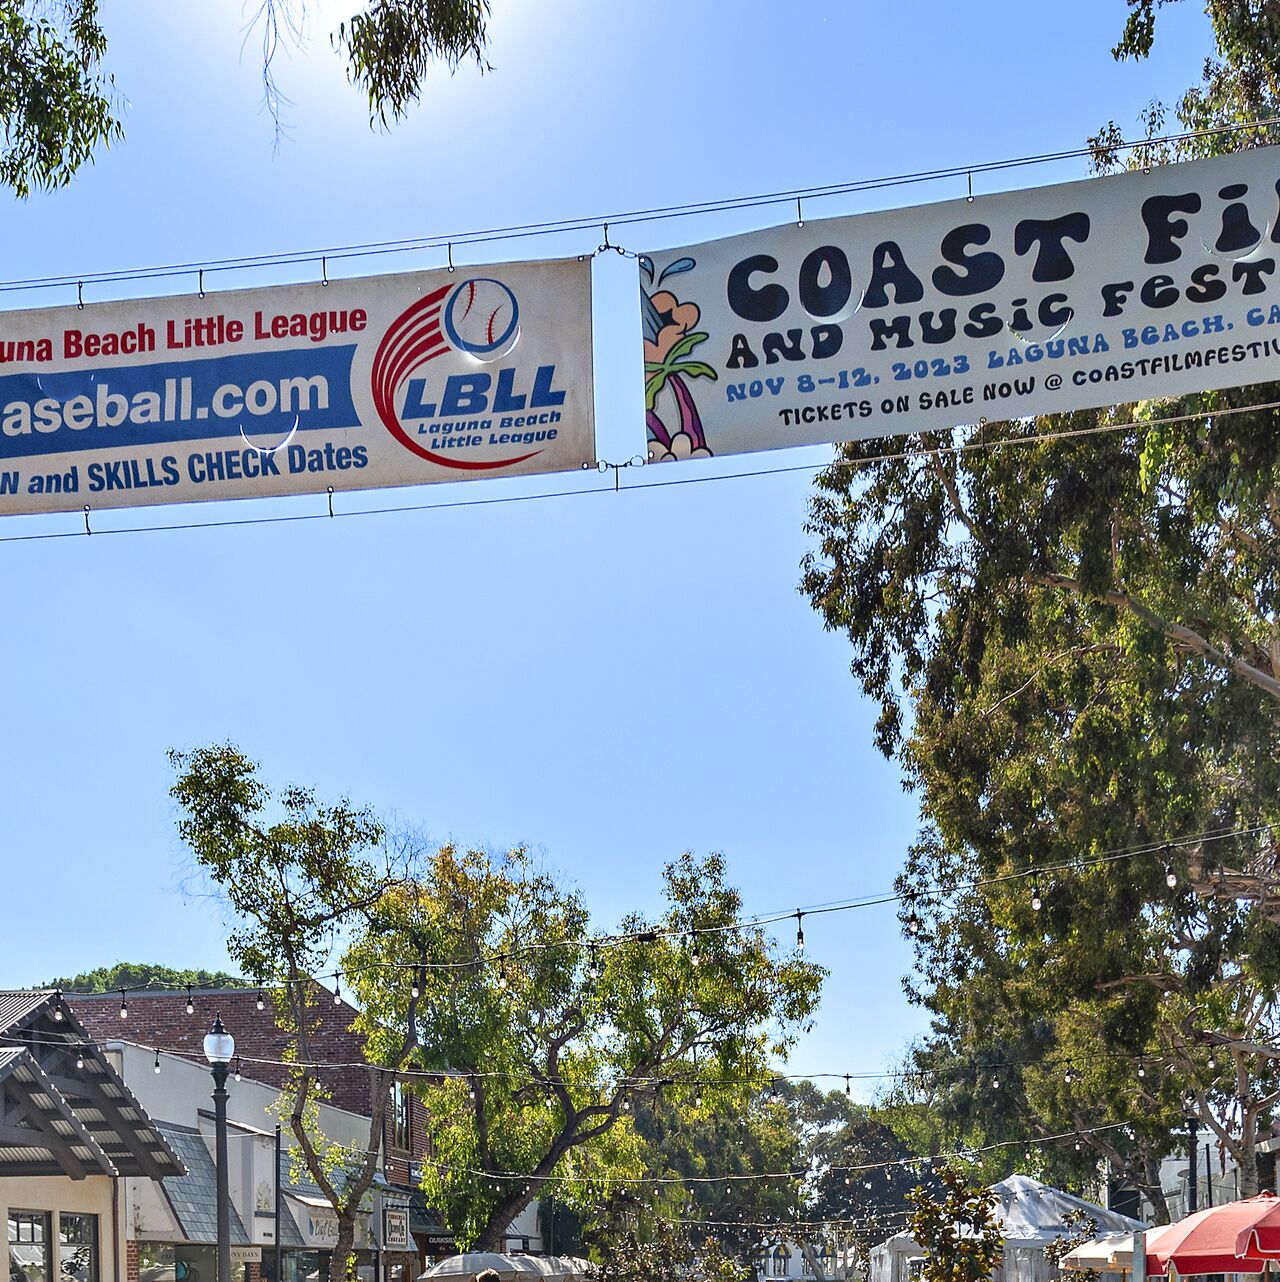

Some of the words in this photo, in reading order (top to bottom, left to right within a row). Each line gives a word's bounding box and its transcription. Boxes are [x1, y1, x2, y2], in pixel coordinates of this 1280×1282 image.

[727, 212, 1091, 322] COAST
[64, 323, 156, 358] Beach
[166, 315, 244, 349] Little
[255, 308, 367, 342] League
[726, 323, 844, 369] AND
[401, 365, 566, 420] LBLL
[726, 376, 785, 402] NOV
[892, 355, 970, 381] 2023
[987, 333, 1110, 369] LAGUNA
[418, 419, 492, 435] Laguna
[499, 411, 561, 428] Beach
[778, 400, 873, 426] TICKETS
[880, 395, 909, 413] ON
[919, 386, 974, 410] SALE
[983, 376, 1035, 401] NOW
[1044, 374, 1063, 391] @
[431, 435, 482, 449] Little
[489, 428, 558, 445] League
[28, 466, 78, 495] and
[87, 456, 180, 492] SKILLS
[187, 448, 278, 483] CHECK
[288, 443, 368, 474] Dates
